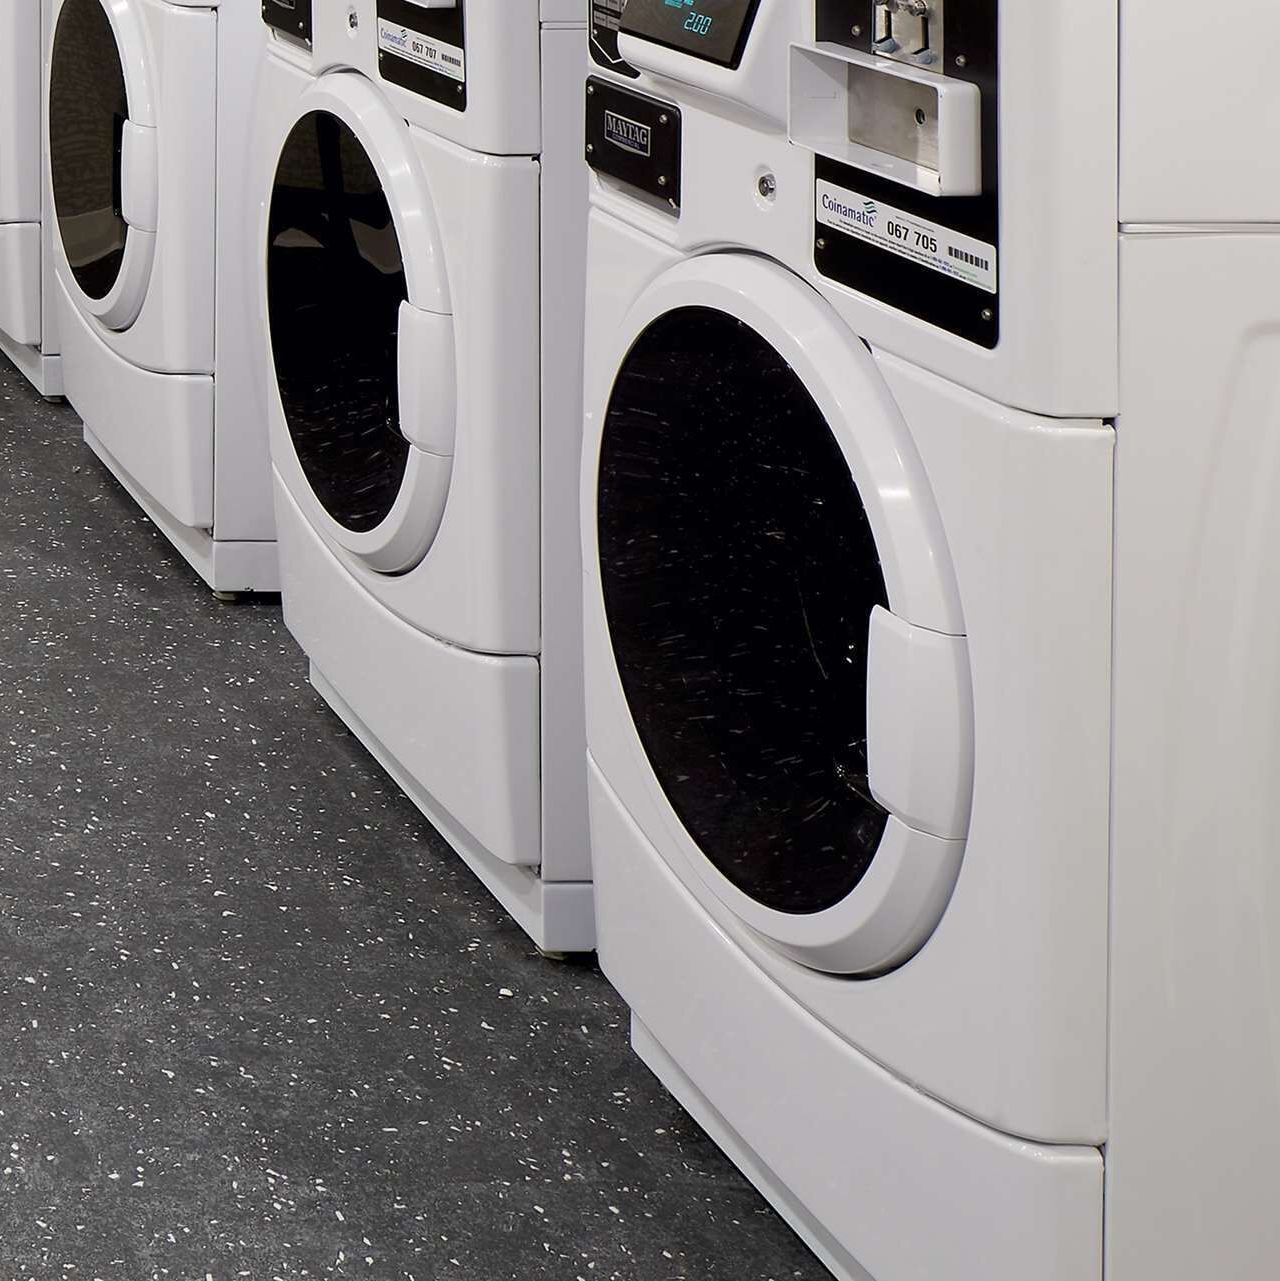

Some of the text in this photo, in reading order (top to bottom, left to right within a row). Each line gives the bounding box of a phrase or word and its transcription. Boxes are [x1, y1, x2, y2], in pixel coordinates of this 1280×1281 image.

[684, 12, 712, 35] 2.00
[607, 115, 647, 145] MAYTAG
[822, 194, 875, 227] Coinamatic
[887, 221, 909, 240] 067
[914, 231, 937, 253] 705
